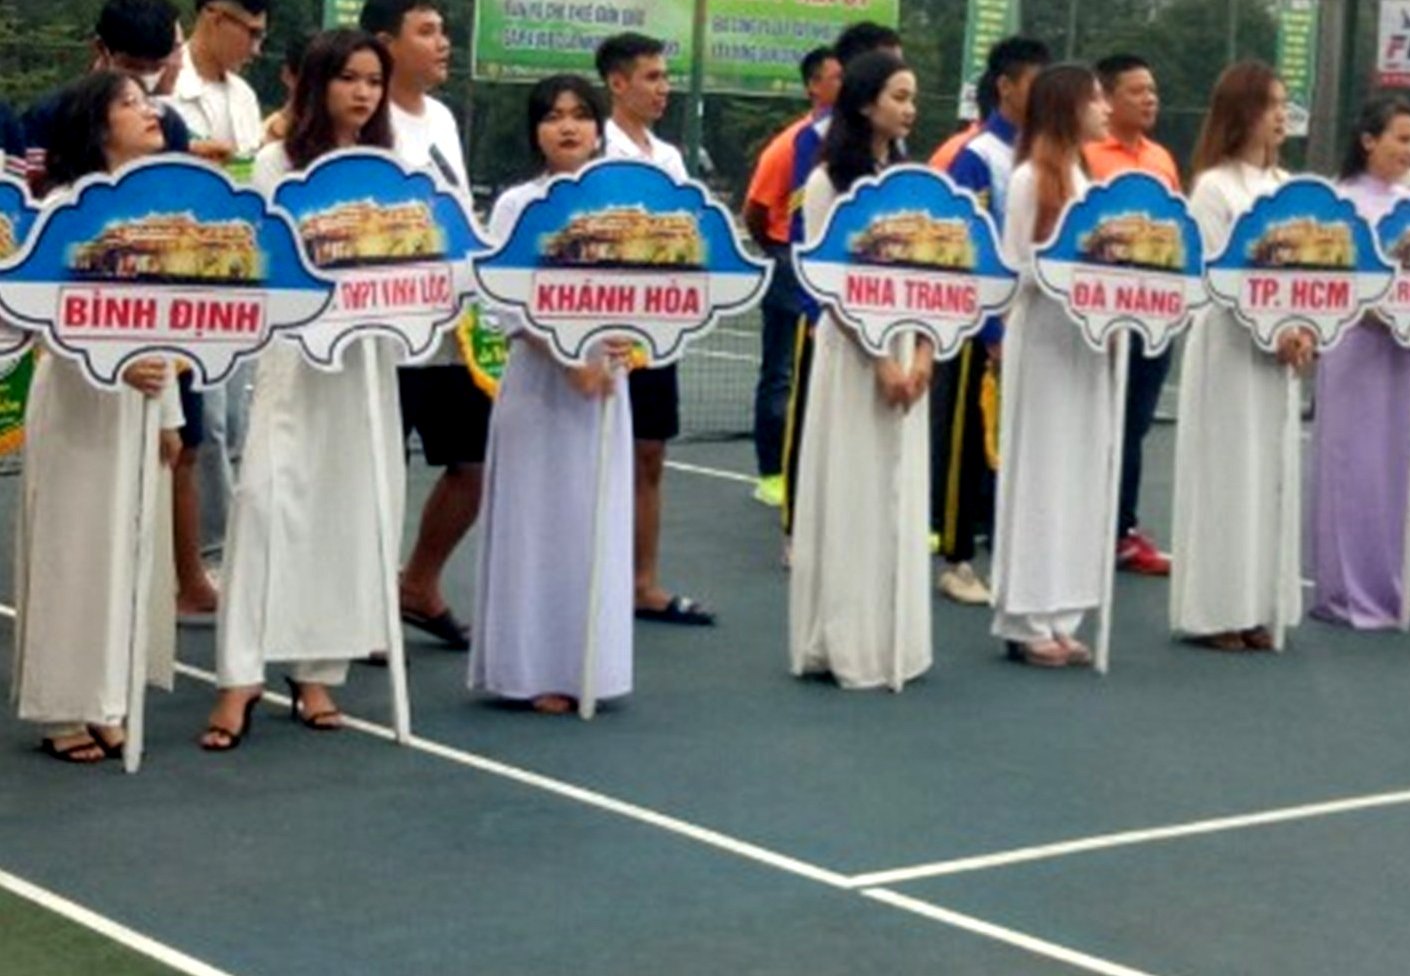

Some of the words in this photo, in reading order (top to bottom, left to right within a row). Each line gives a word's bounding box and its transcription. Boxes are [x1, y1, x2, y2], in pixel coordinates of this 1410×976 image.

[536, 278, 635, 313] KHÁNH
[643, 278, 701, 314] HÒA
[846, 274, 896, 308] NHA
[904, 279, 977, 314] TRANG
[1247, 276, 1282, 308] TP.
[1290, 278, 1350, 309] HCM
[169, 299, 261, 338] ĐỊNH
